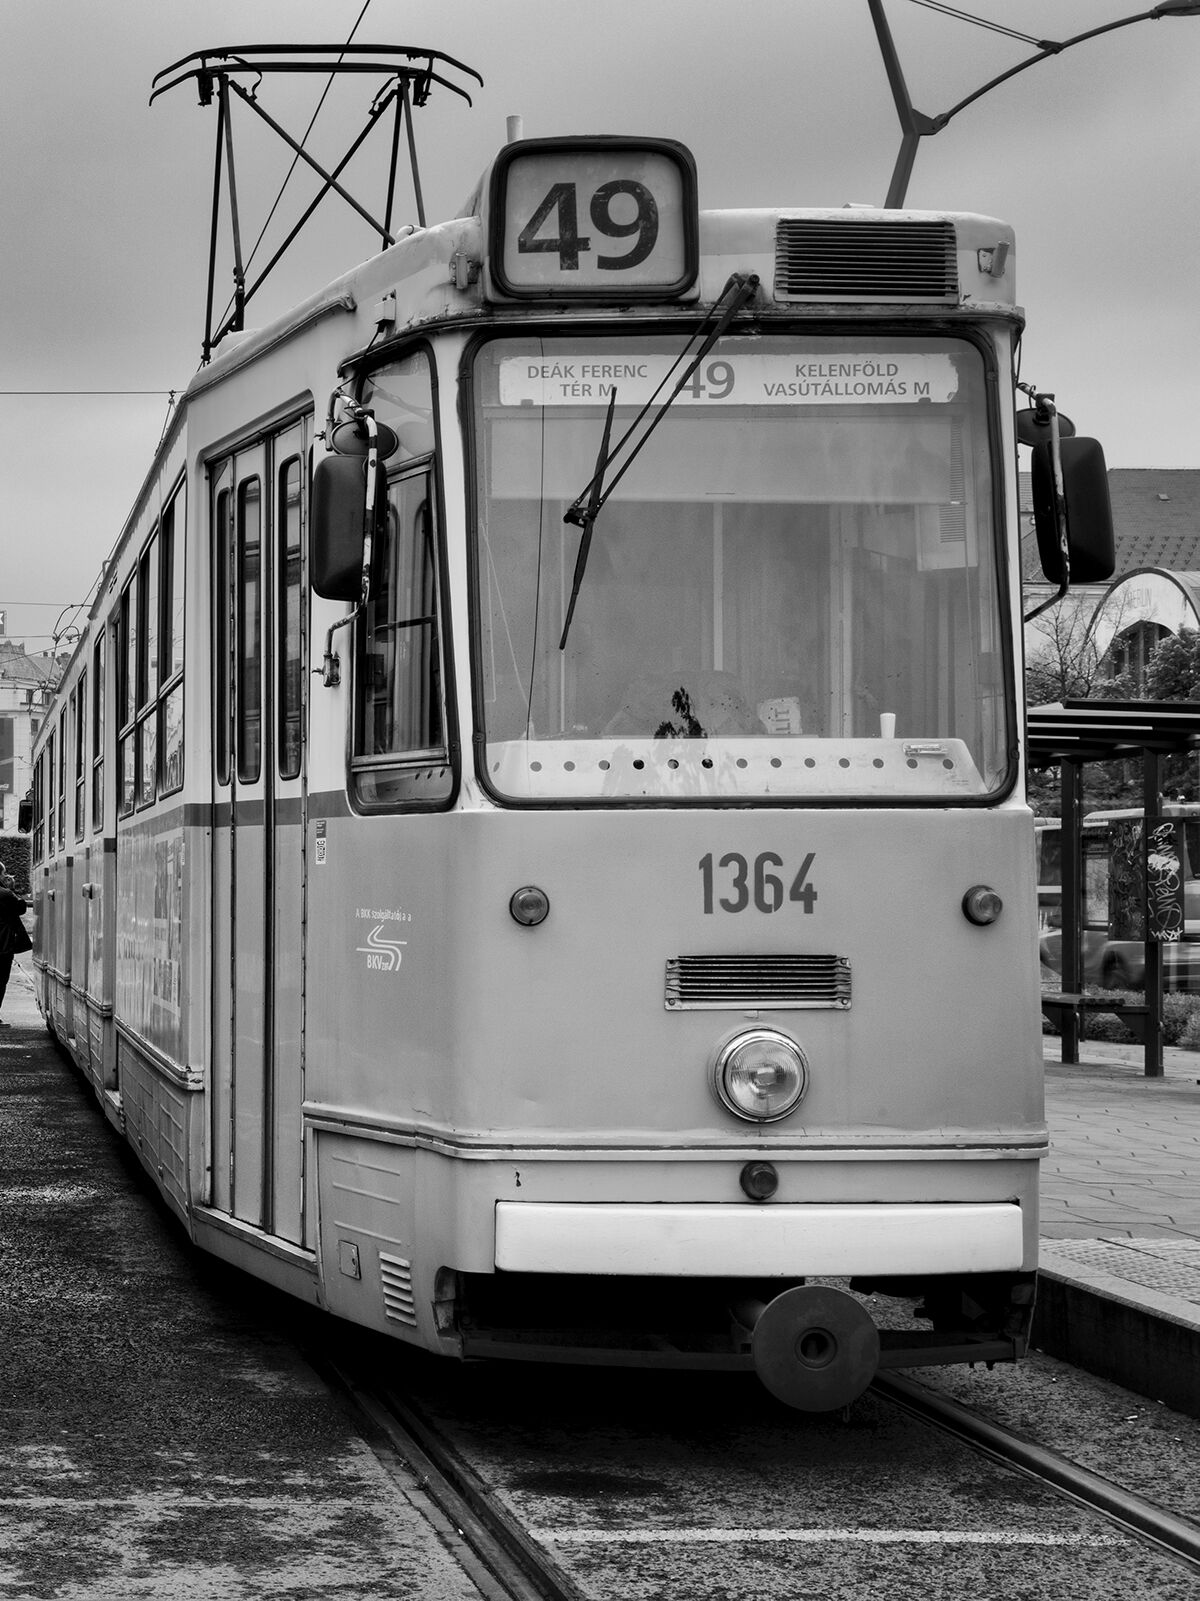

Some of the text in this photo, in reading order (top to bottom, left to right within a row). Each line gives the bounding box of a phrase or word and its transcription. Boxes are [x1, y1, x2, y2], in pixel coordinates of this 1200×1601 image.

[518, 179, 659, 271] 49
[527, 363, 648, 379] DEÁK FERENC
[795, 362, 899, 378] KELENFÖLD
[676, 361, 735, 399] 49
[763, 379, 931, 397] VASÚTÁLLOMÁS M
[559, 381, 615, 398] TÉR M
[698, 851, 818, 915] 1364
[355, 908, 360, 918] A
[361, 908, 371, 919] BKK
[367, 954, 383, 970] BKV
